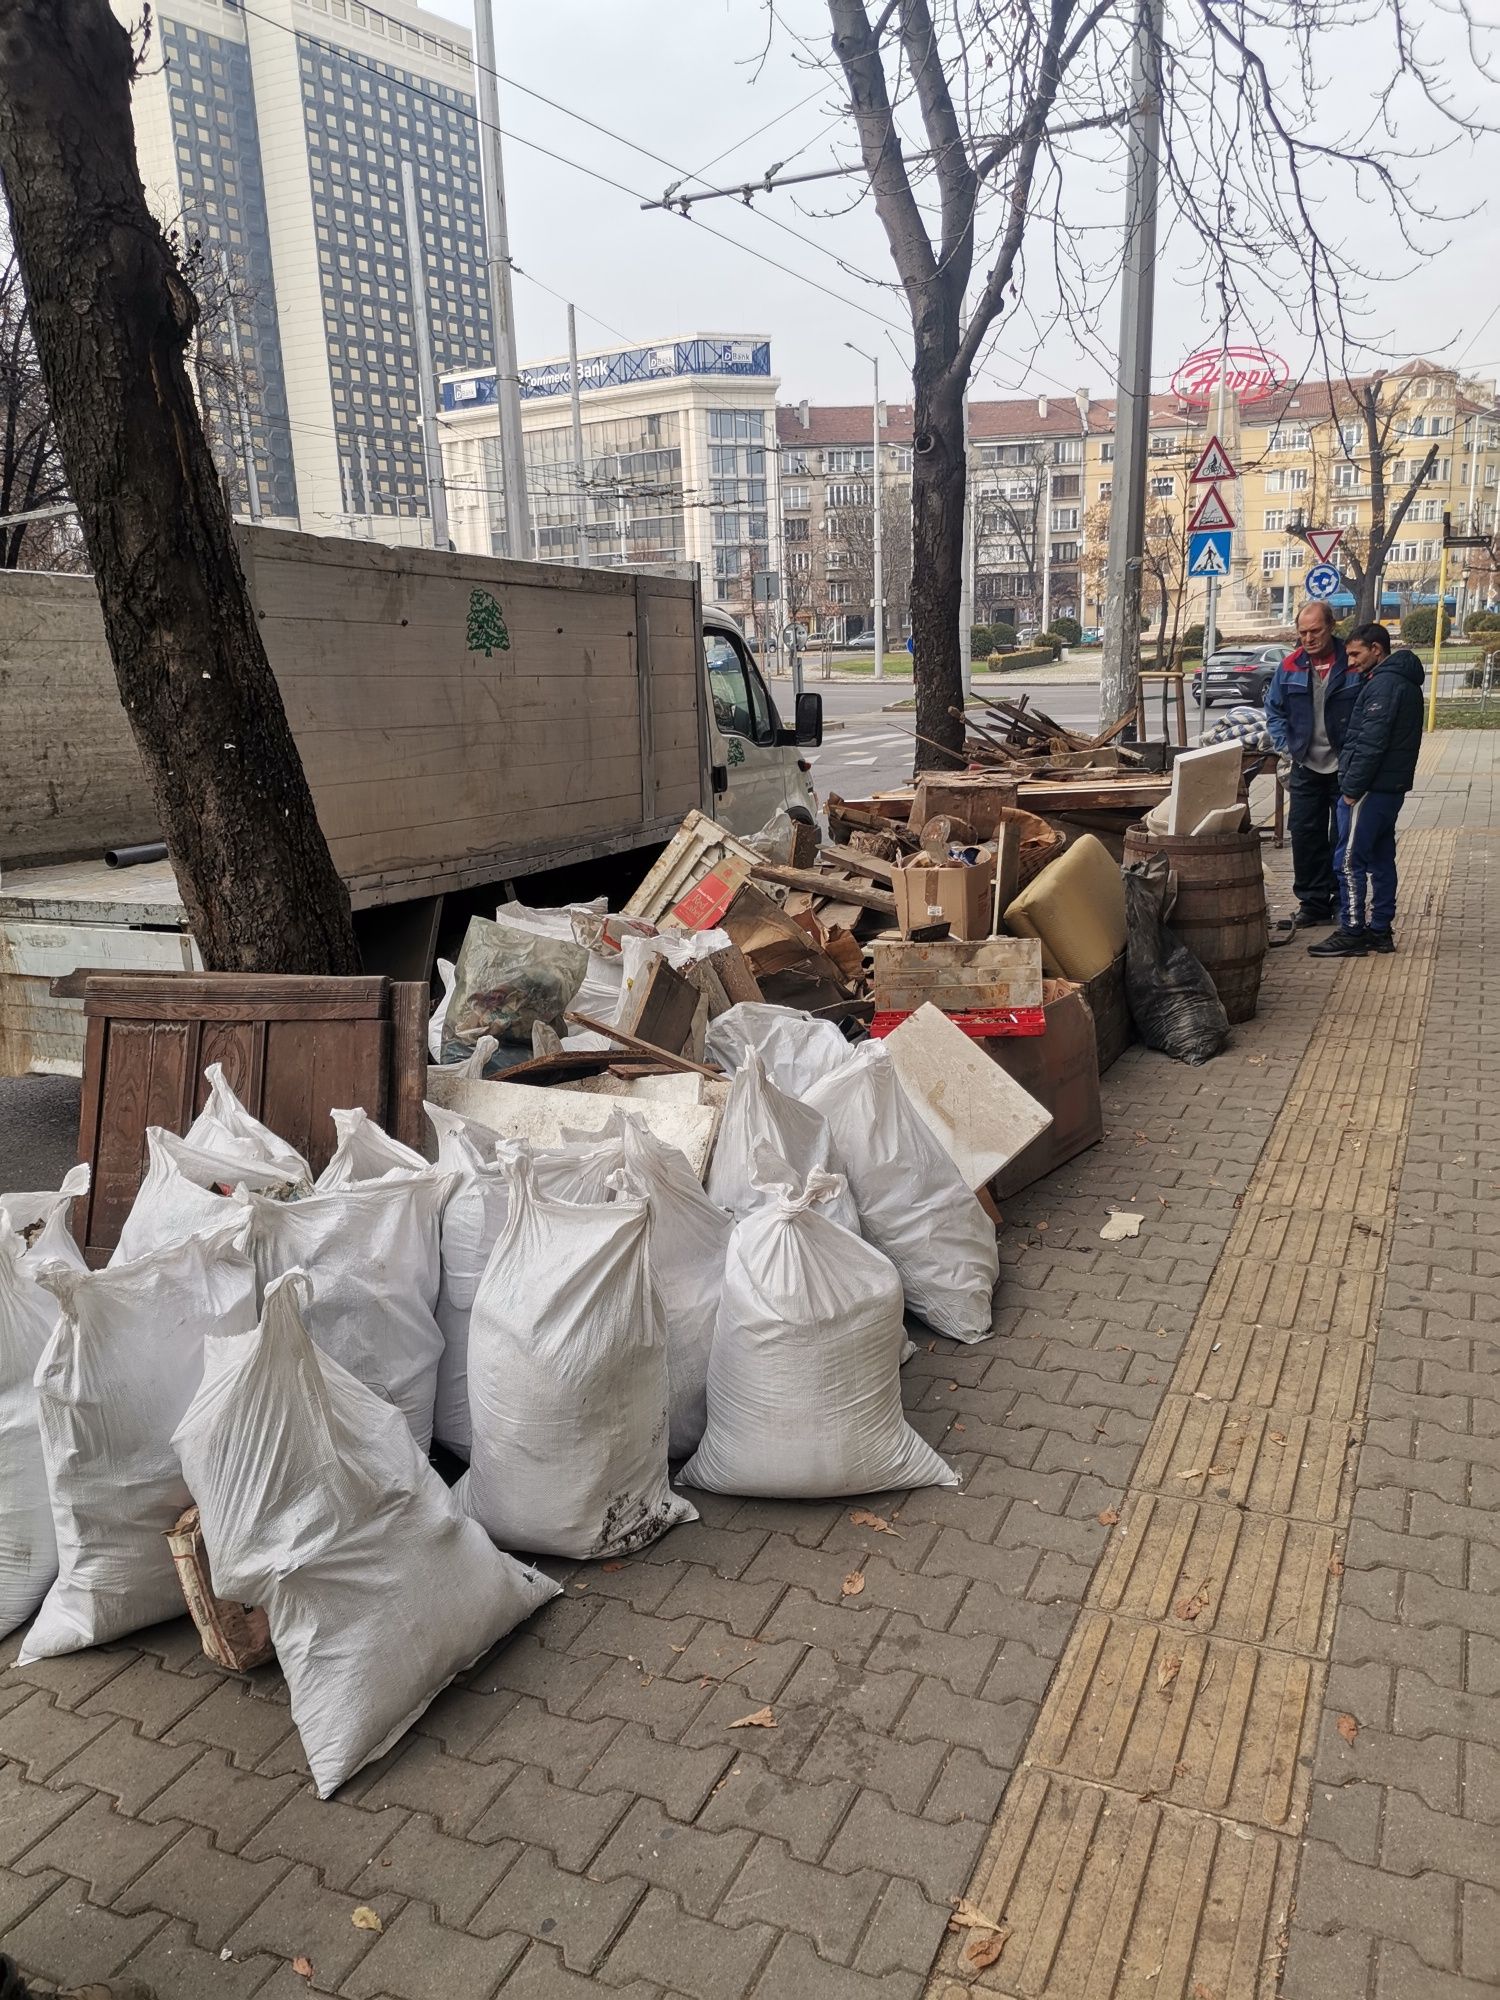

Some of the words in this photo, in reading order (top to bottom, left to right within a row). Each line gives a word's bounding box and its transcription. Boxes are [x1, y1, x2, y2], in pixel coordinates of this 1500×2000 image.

[733, 351, 750, 360] Bank
[525, 372, 571, 388] Commerc
[1185, 362, 1275, 398] Happy
